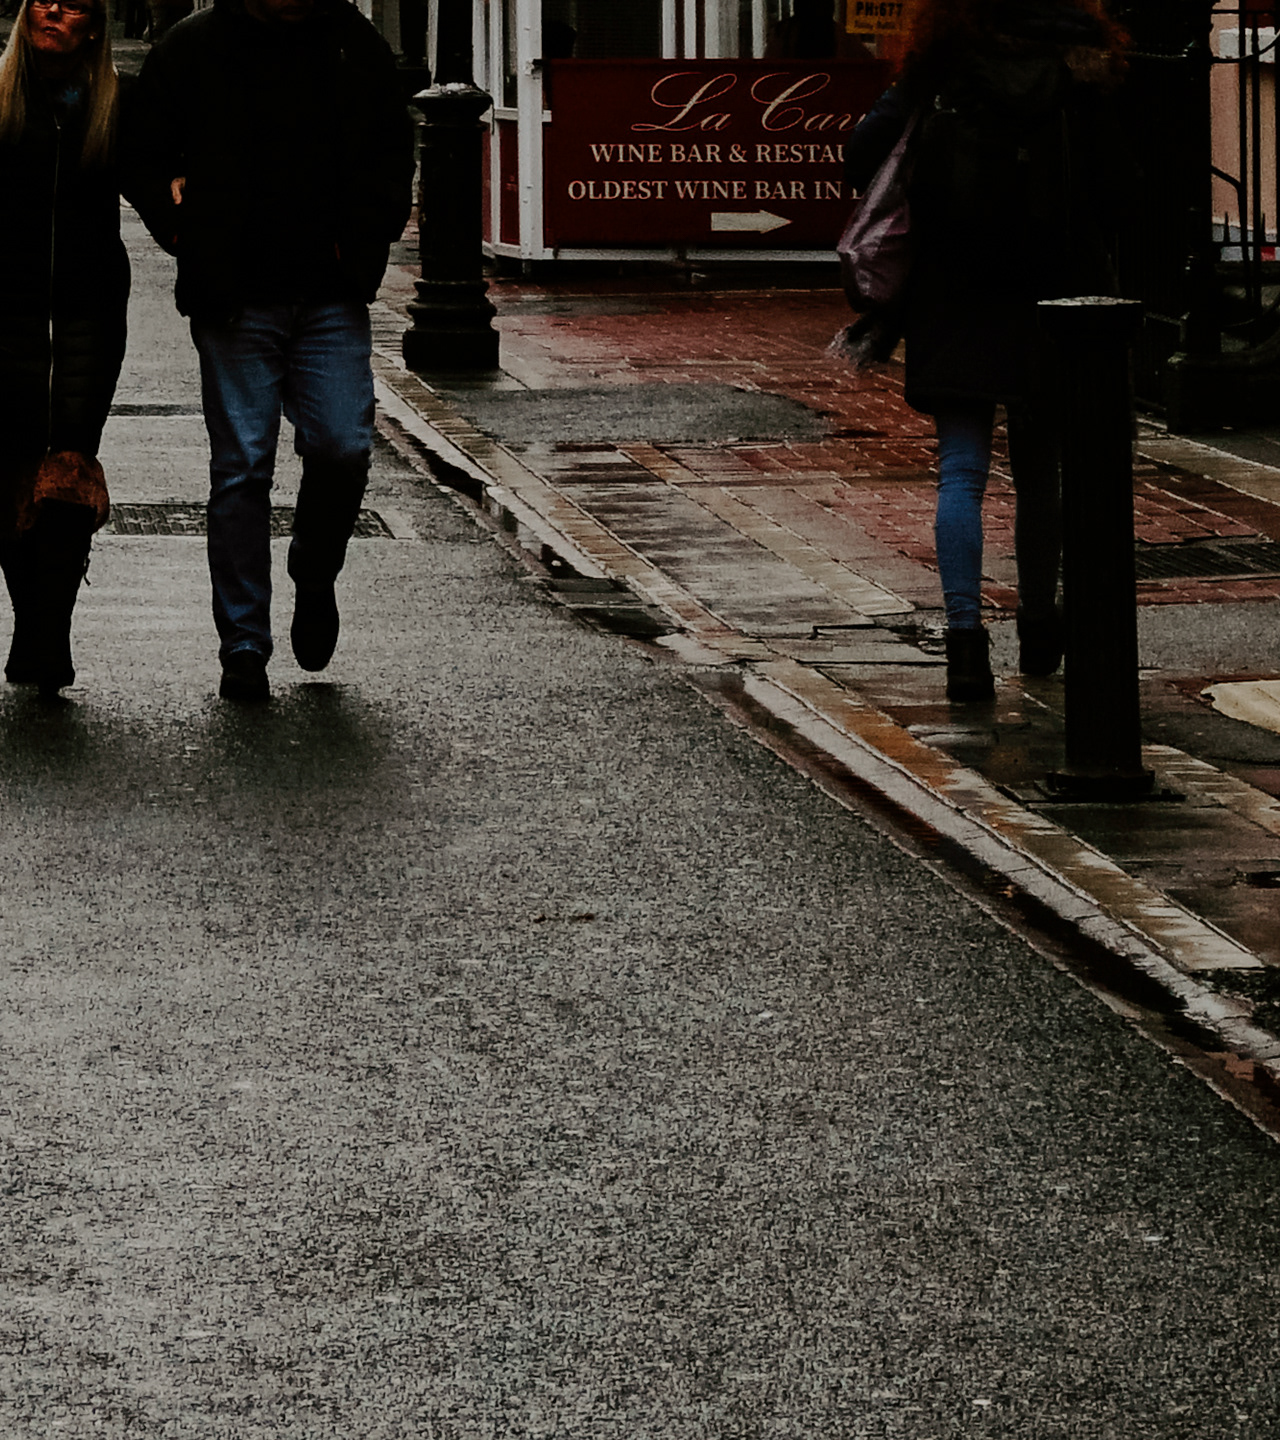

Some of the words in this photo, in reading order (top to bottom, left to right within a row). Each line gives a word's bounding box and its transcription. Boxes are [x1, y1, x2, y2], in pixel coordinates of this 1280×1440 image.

[630, 71, 738, 132] La
[750, 71, 867, 132] Cav
[589, 143, 662, 164] WINE
[669, 143, 723, 164] BAR
[728, 143, 749, 164] &
[567, 179, 669, 201] OLDEST
[674, 179, 748, 201] WINE
[754, 179, 807, 201] BAR
[813, 179, 843, 201] IN
